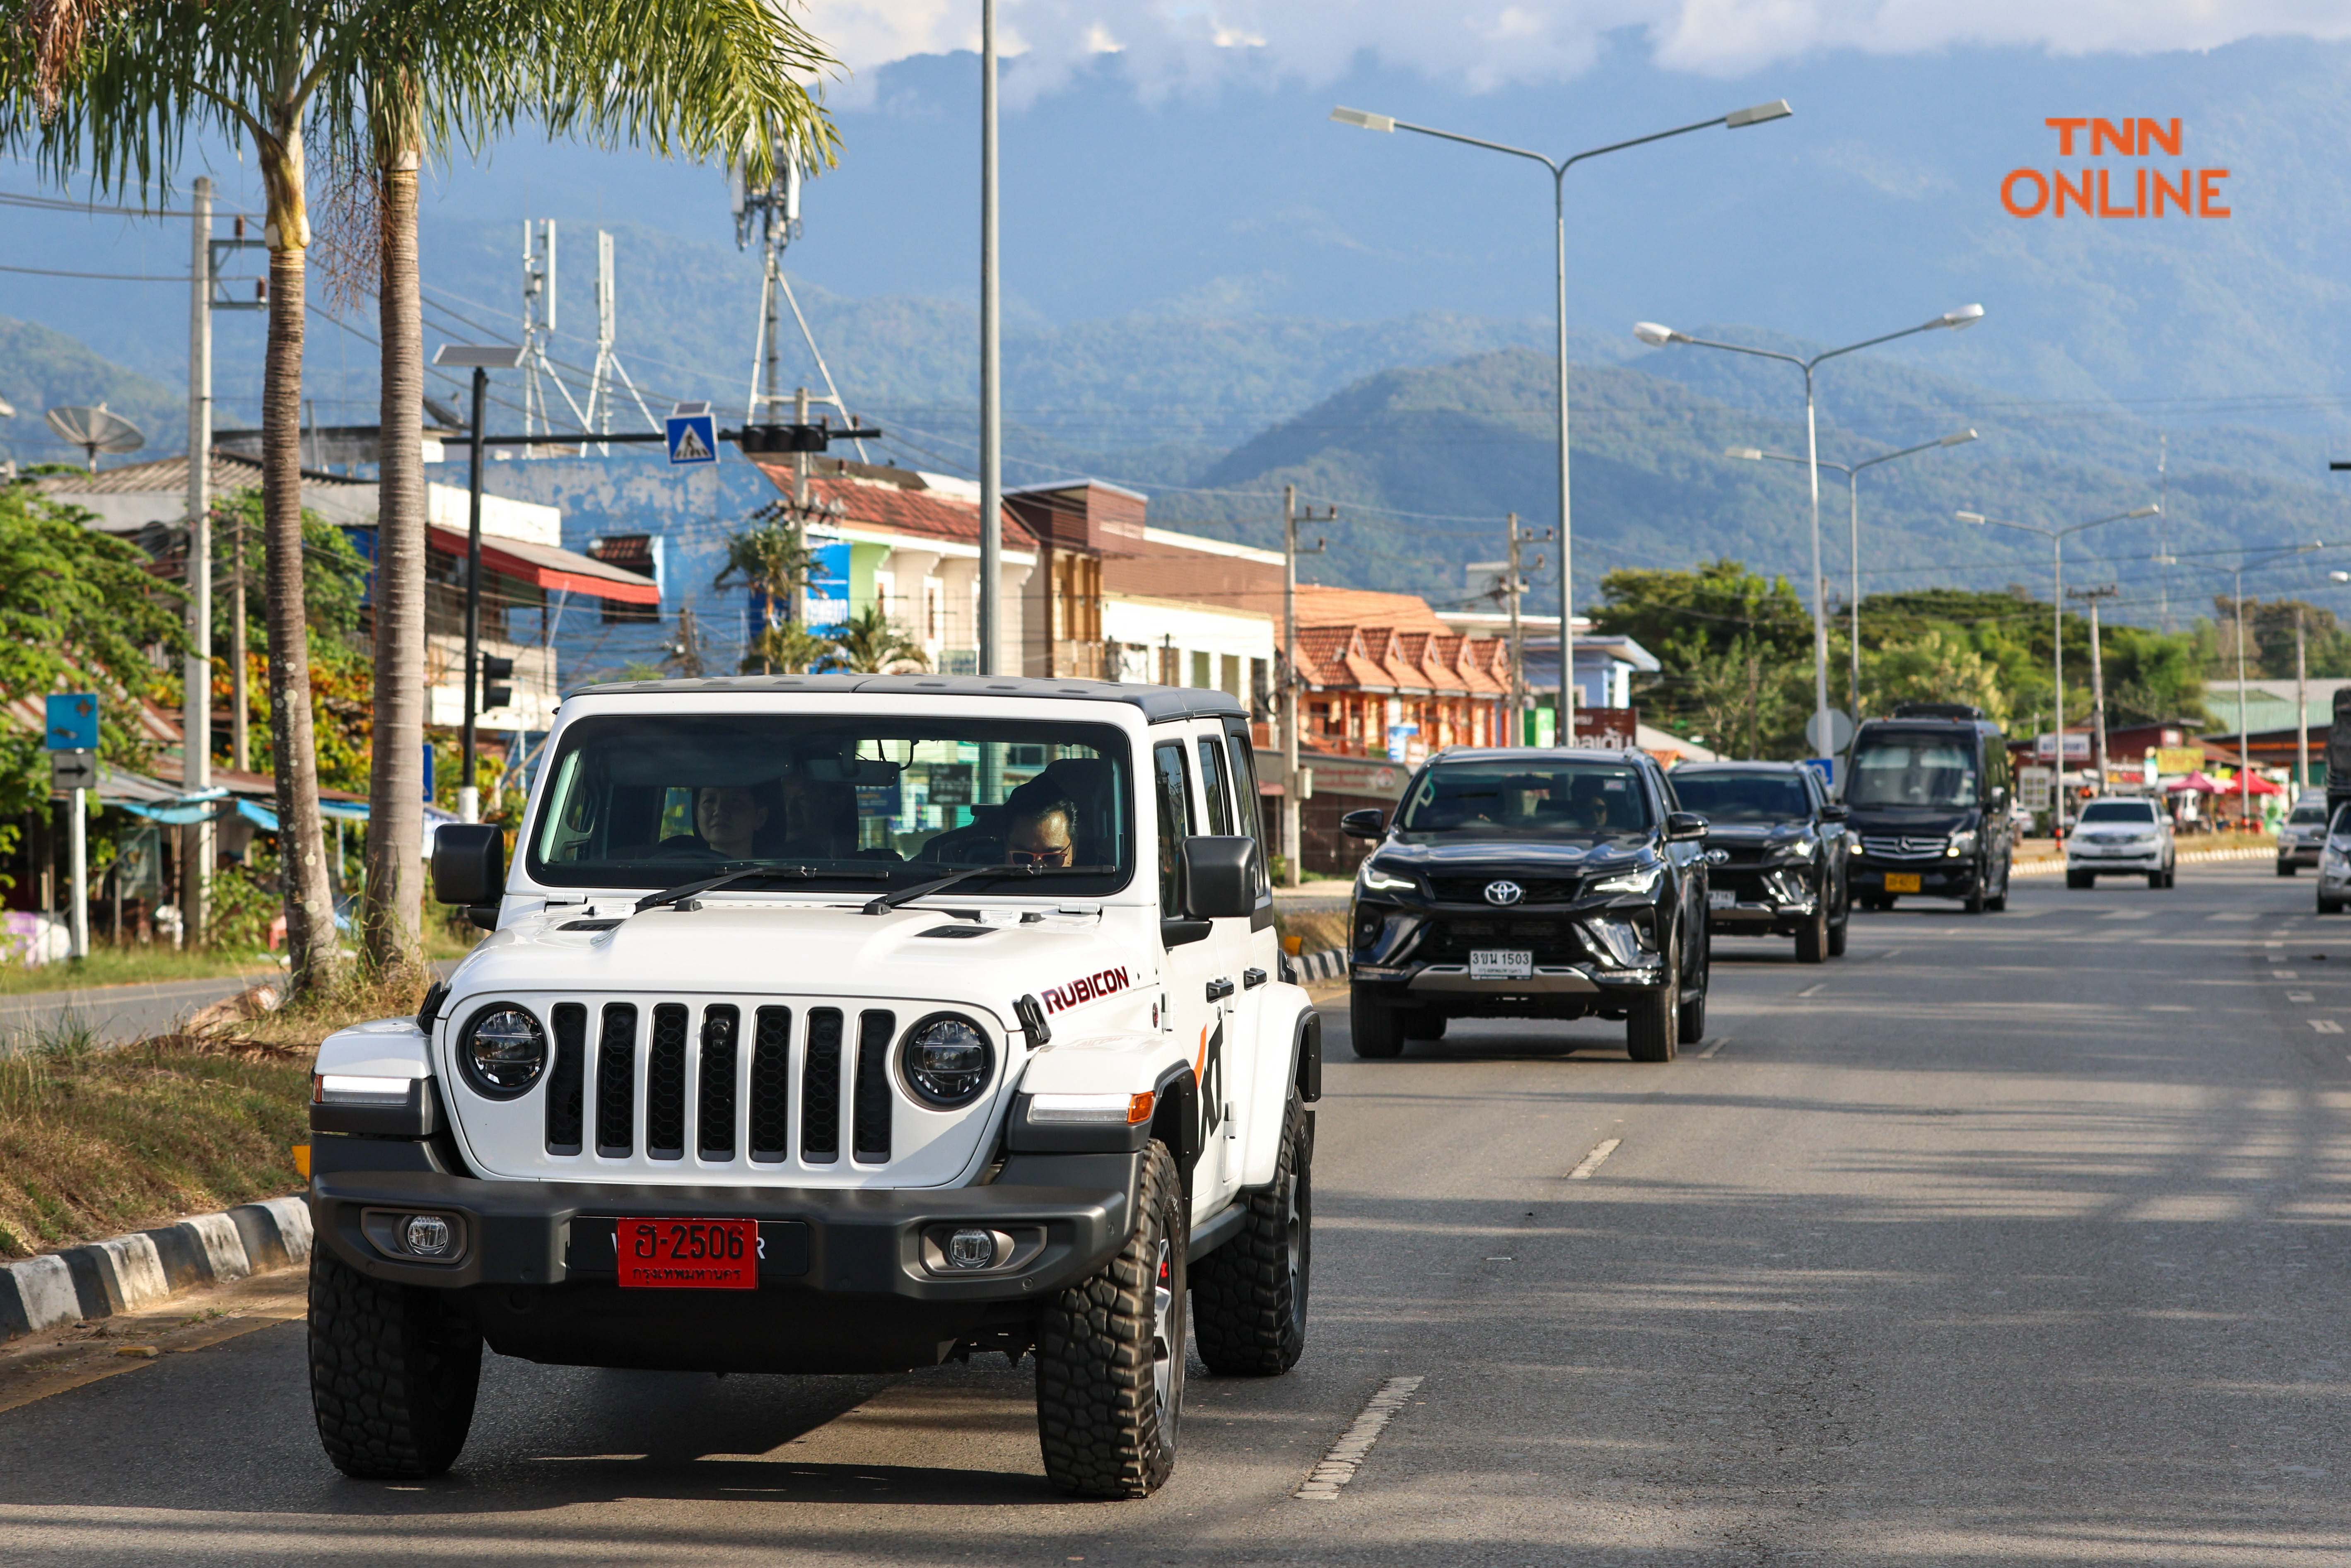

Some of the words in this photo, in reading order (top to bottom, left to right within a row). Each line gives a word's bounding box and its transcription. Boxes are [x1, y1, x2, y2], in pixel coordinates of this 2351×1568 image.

[1472, 953, 1497, 965] 3ขน
[1502, 953, 1529, 965] 1503
[1040, 965, 1130, 1015] RUBICON
[632, 1267, 742, 1284] กรุงเทพมหานคร
